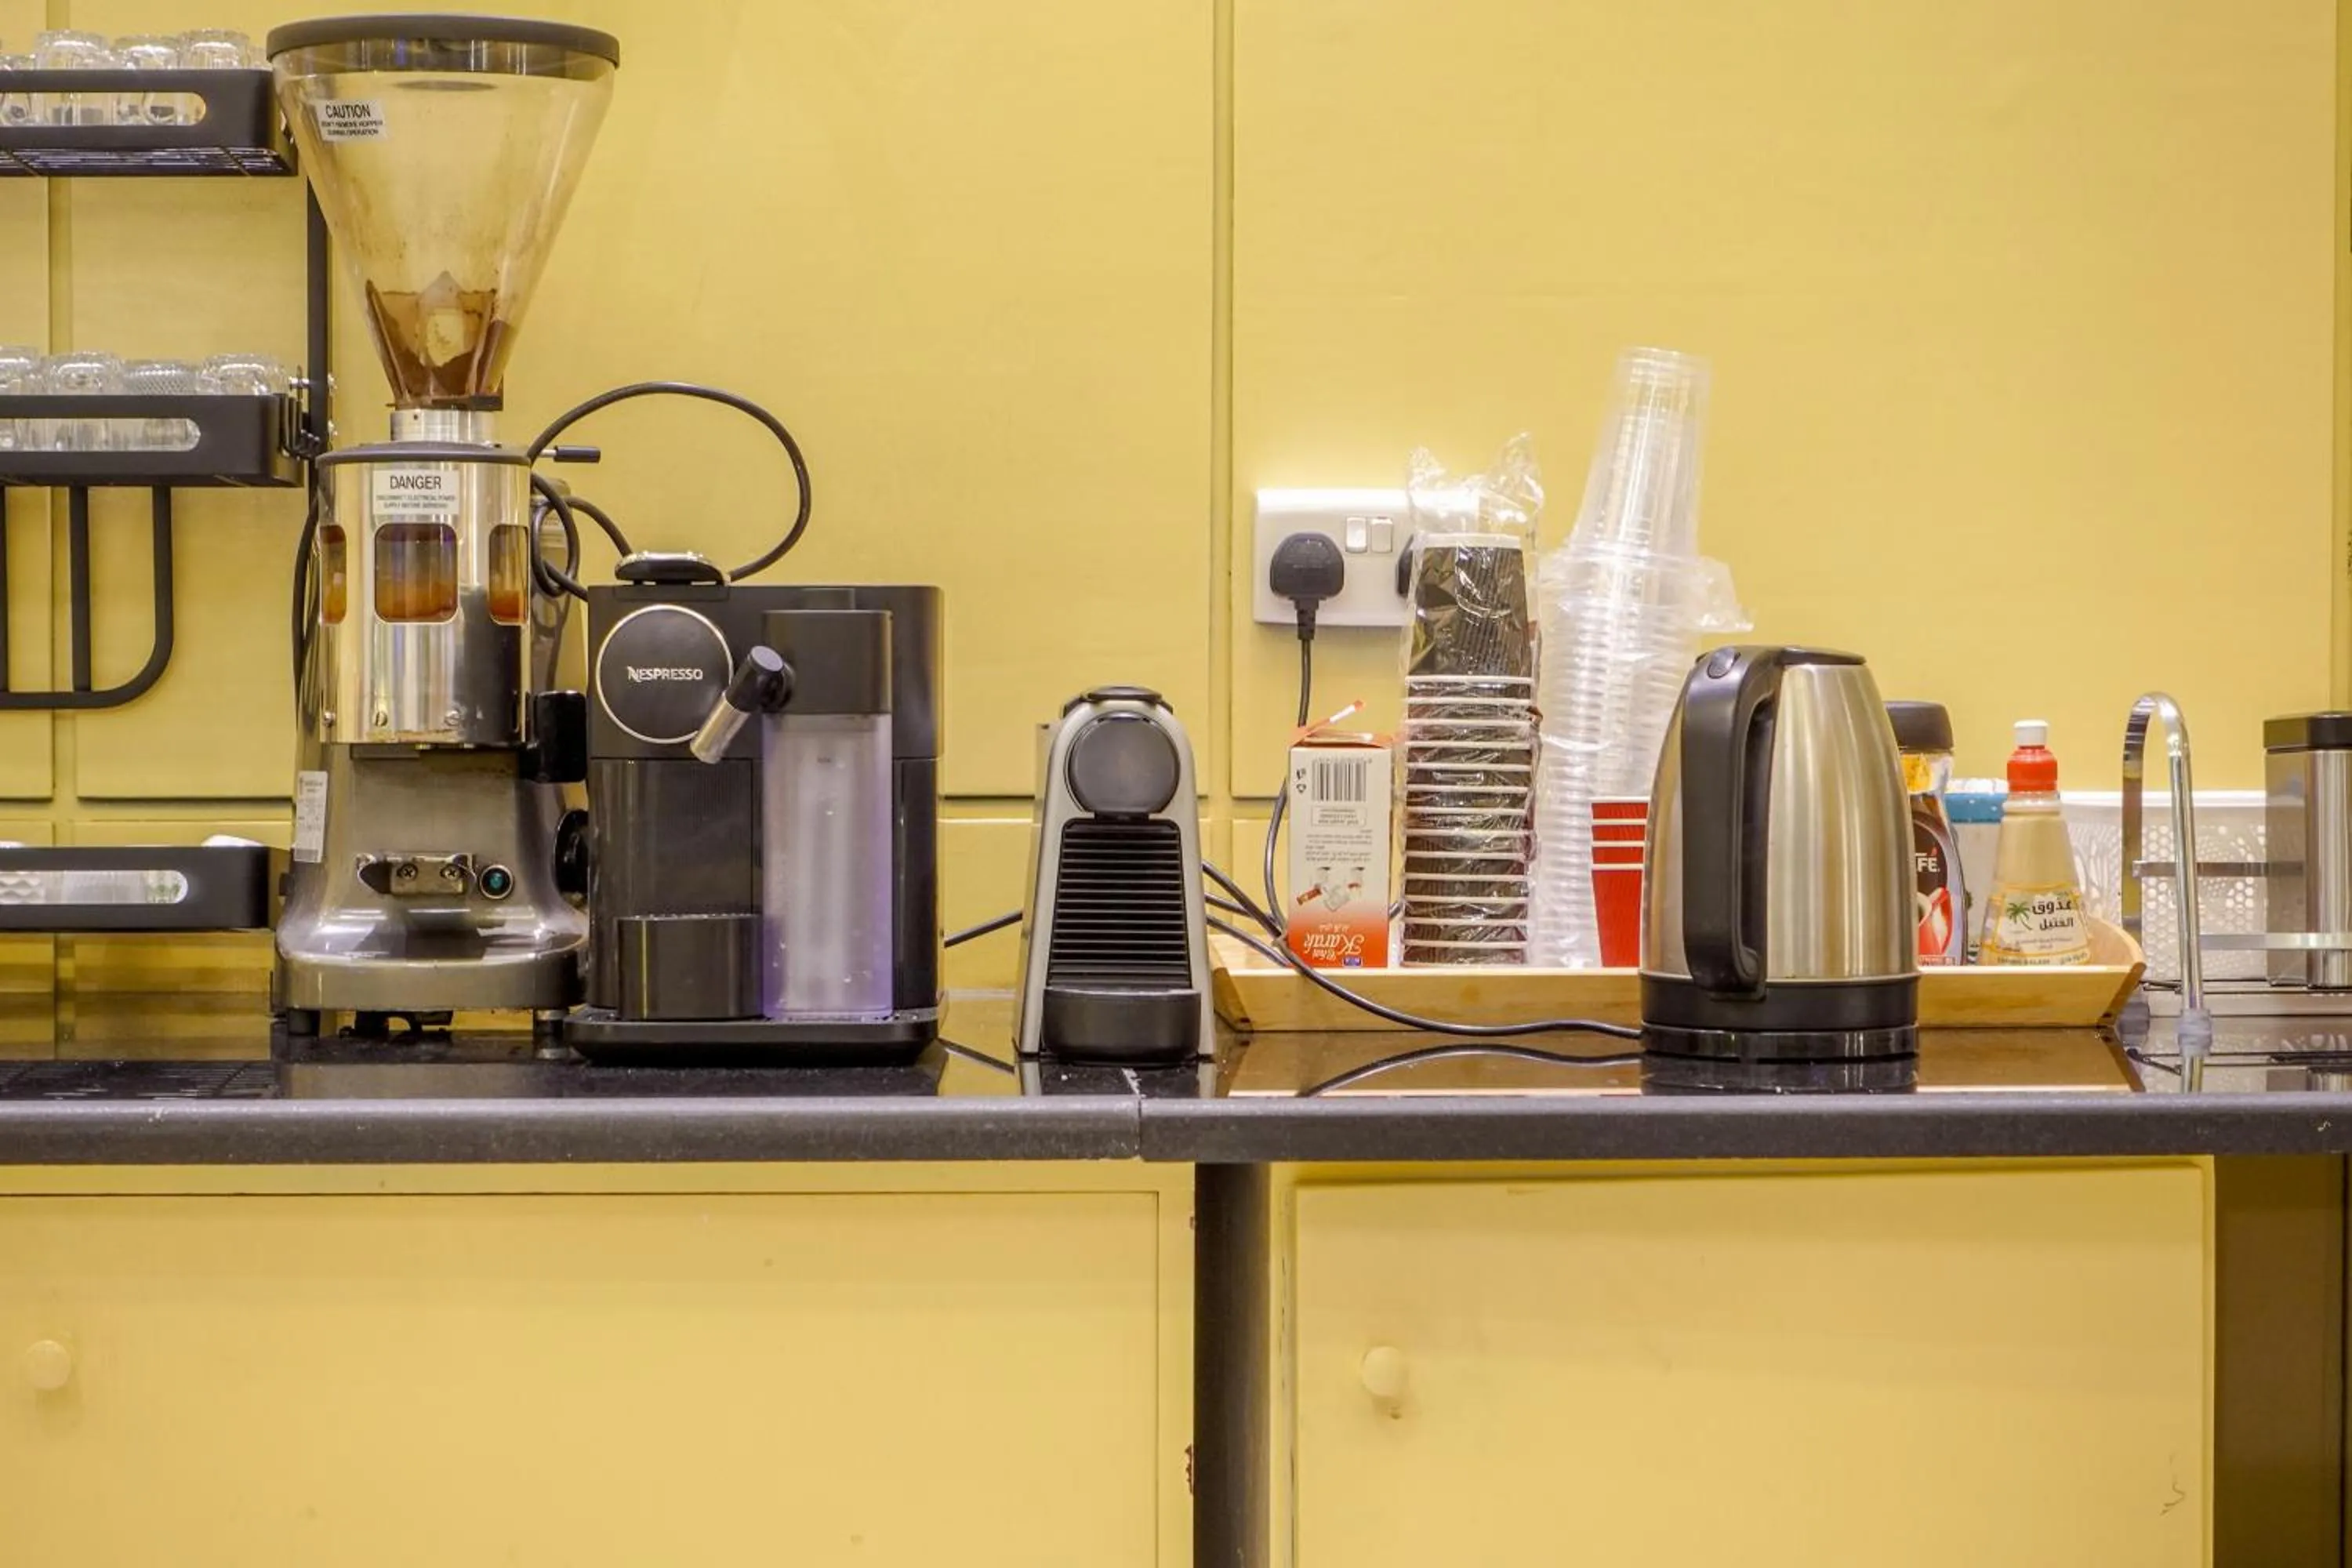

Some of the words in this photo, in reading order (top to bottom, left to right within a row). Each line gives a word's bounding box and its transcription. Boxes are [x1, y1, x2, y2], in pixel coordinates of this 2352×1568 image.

[325, 104, 371, 118] CAUTION
[390, 475, 441, 489] DANGER
[626, 666, 703, 683] NESPRESSO
